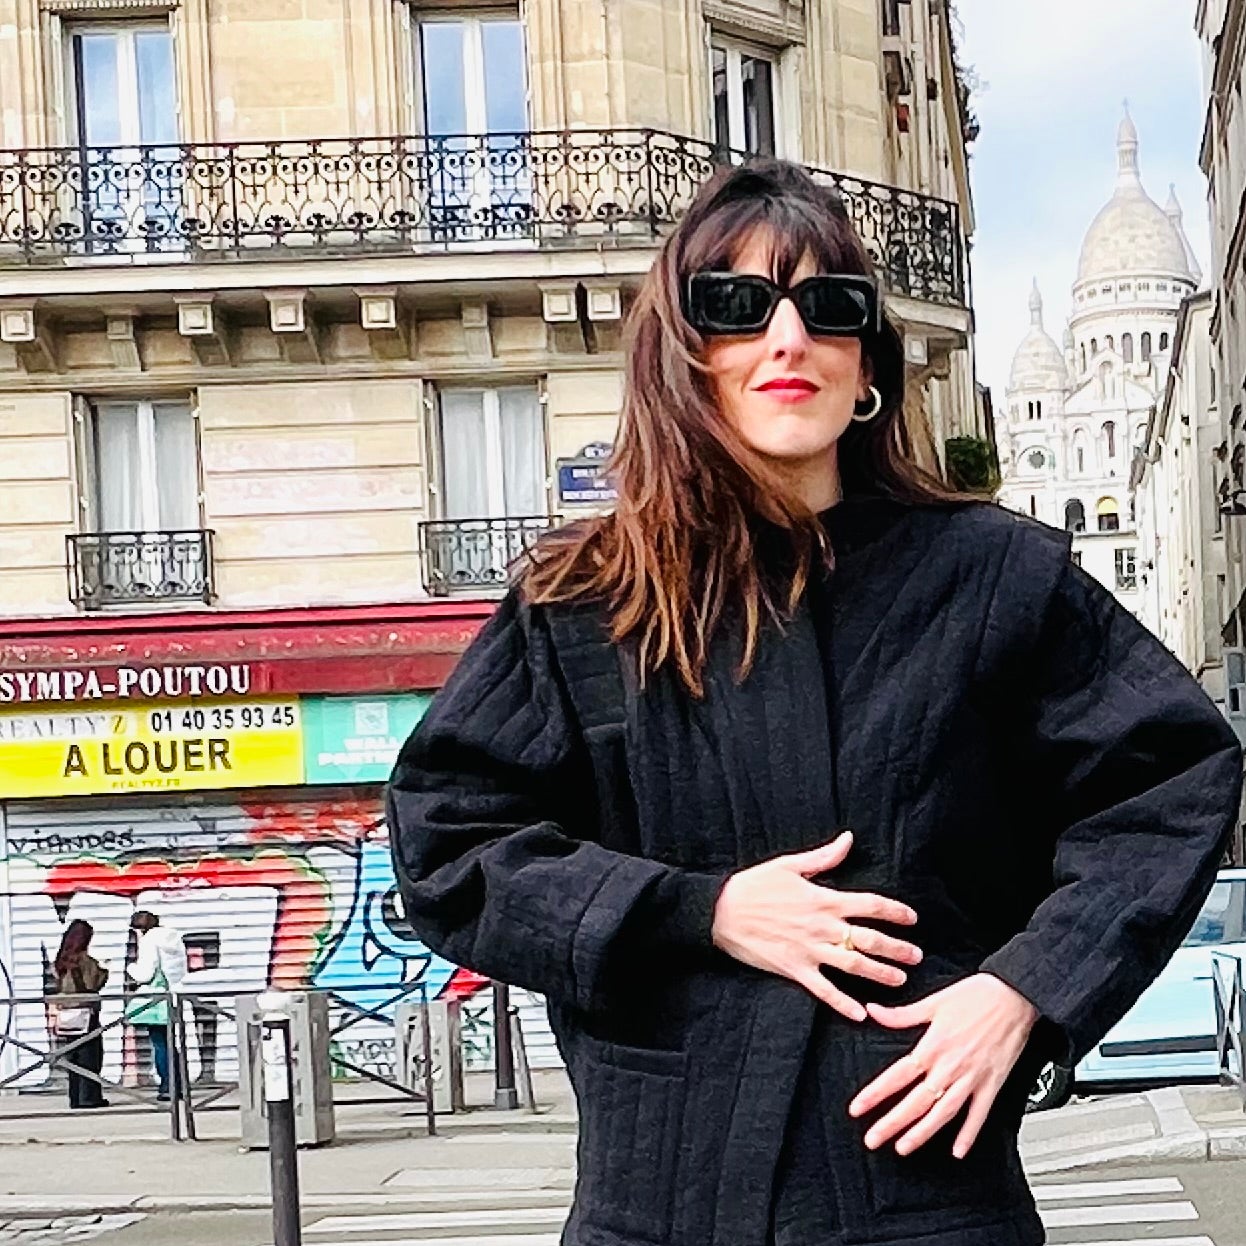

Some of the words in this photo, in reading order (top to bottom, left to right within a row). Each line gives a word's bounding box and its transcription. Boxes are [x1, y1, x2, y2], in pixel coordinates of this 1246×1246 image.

[0, 664, 250, 702] SYMPA-POUTOU
[151, 710, 172, 732] 01
[182, 709, 205, 731] 40
[212, 708, 234, 729] 35
[241, 706, 264, 728] 93
[272, 705, 294, 727] 45
[63, 744, 88, 777] A
[102, 738, 232, 776] LOUER
